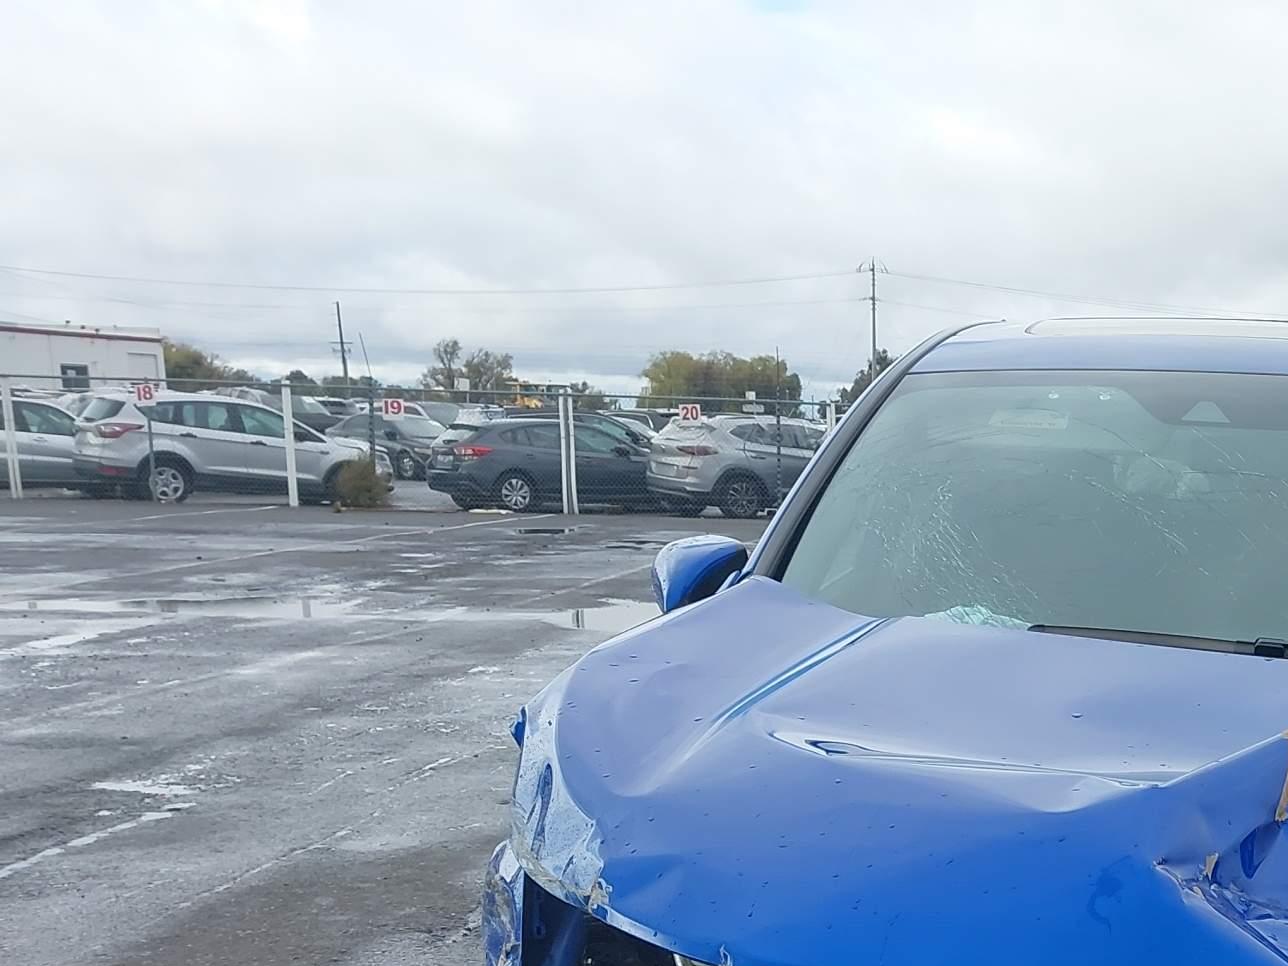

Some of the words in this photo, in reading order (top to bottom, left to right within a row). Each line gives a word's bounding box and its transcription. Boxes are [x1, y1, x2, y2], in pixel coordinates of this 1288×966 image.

[137, 385, 153, 401] 18
[384, 400, 401, 415] 19
[681, 405, 699, 420] 20
